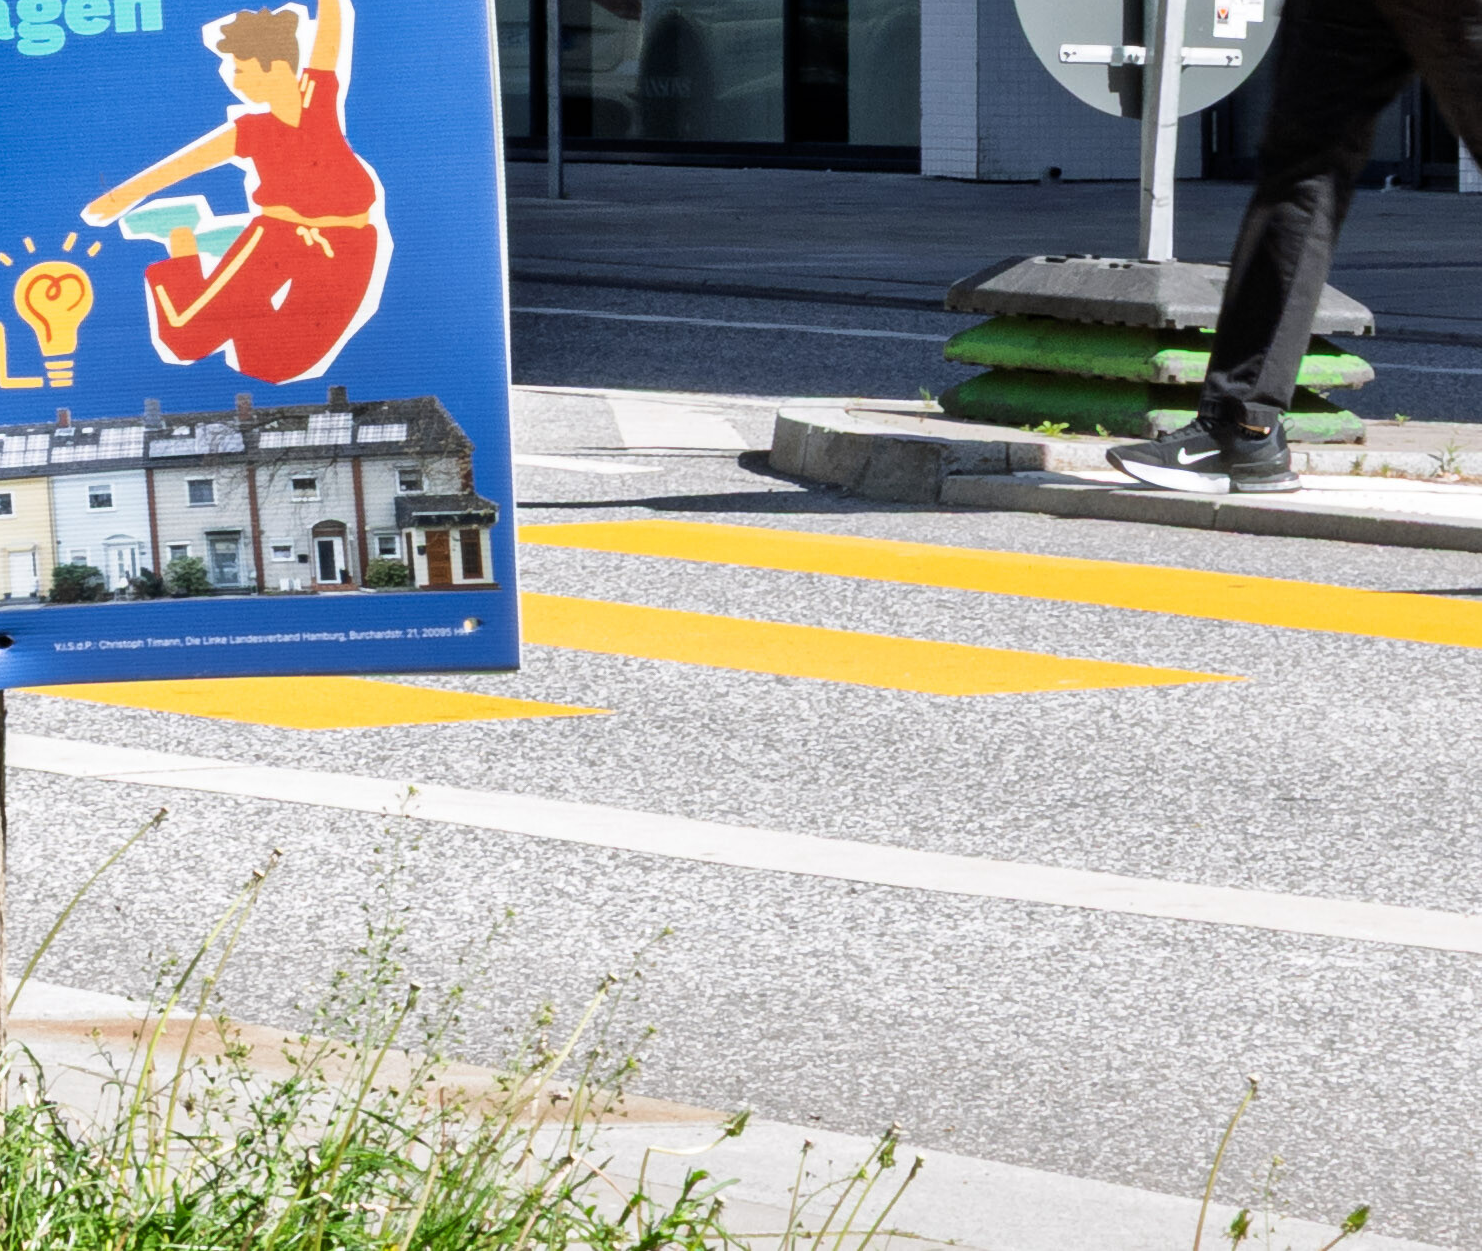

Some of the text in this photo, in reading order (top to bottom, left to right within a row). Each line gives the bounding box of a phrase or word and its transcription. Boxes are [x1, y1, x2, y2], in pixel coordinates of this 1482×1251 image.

[98, 638, 145, 651] Christoph
[184, 635, 201, 647] Die
[202, 634, 228, 646] Linke
[229, 631, 301, 645] Landesverband
[302, 630, 347, 643] Hamburg,
[349, 628, 405, 641] Burchardstr.
[421, 626, 452, 638] 20095
